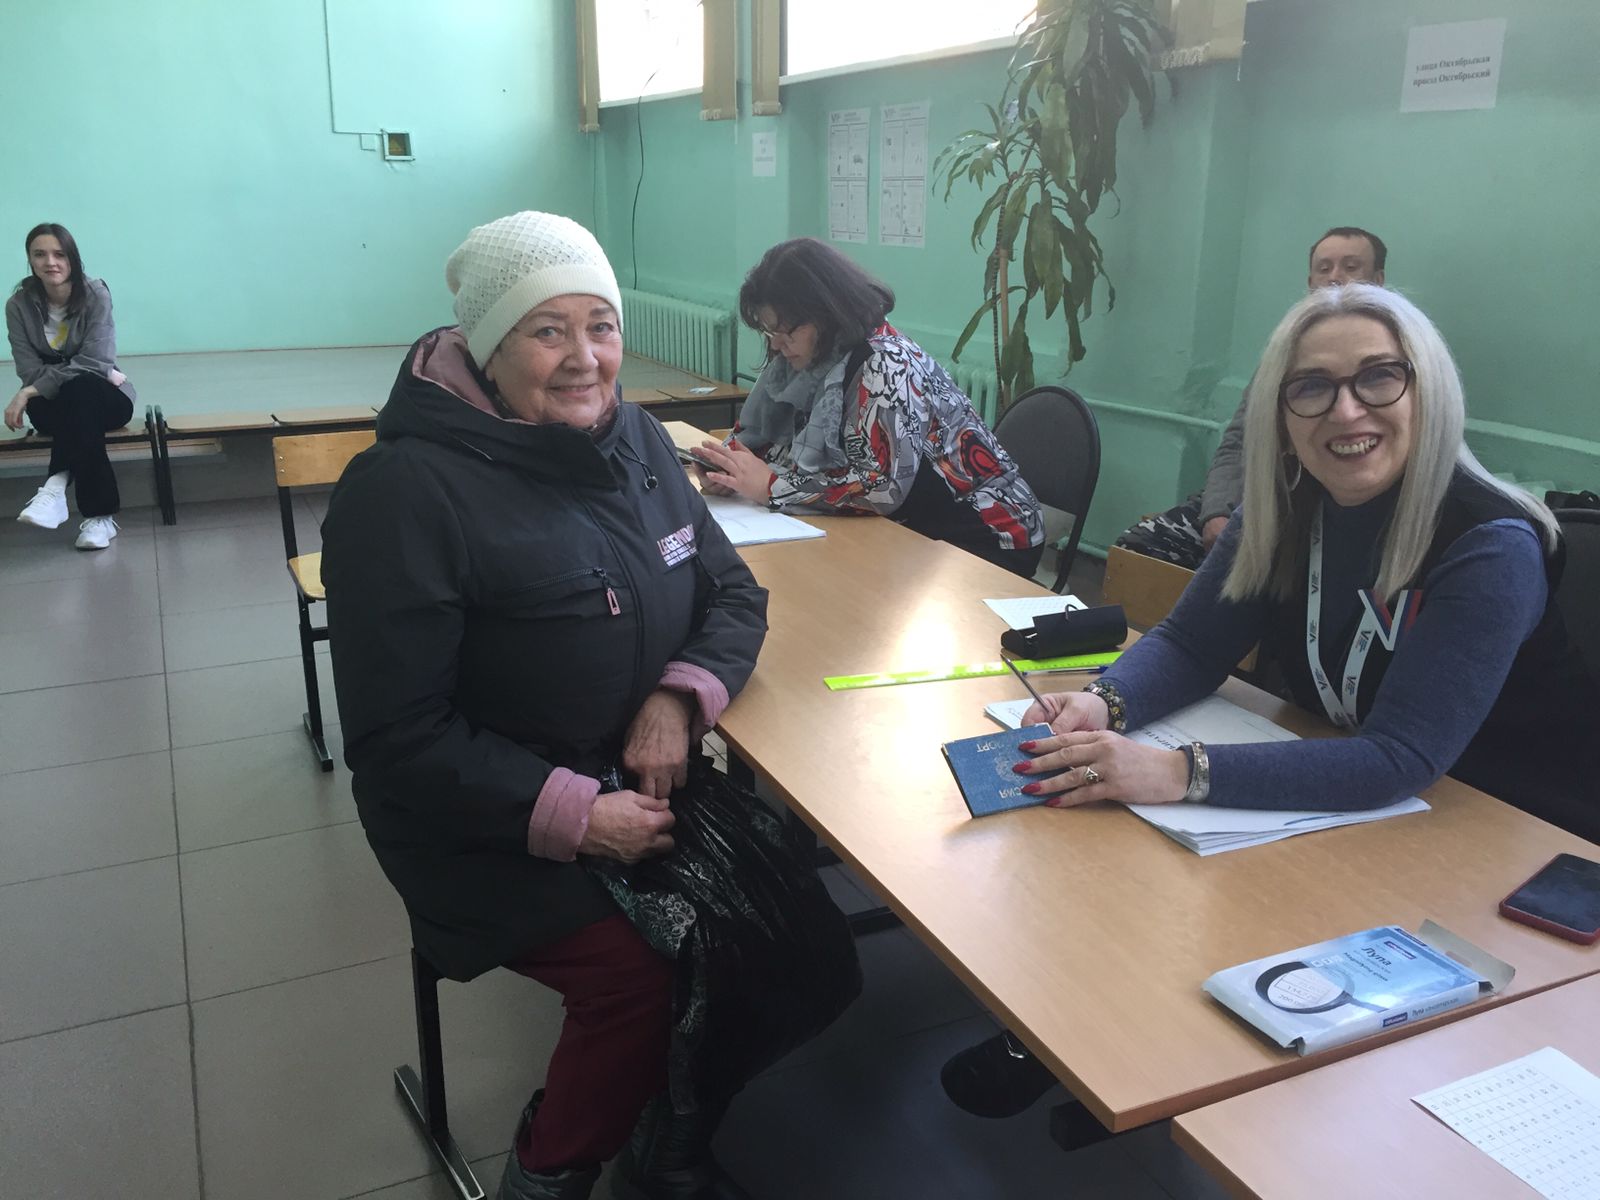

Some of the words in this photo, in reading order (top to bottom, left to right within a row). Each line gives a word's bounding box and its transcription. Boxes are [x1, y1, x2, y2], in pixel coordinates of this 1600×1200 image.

[1439, 69, 1491, 83] Октябрьский
[998, 785, 1024, 799] СИЯ
[1360, 947, 1392, 966] Лупа
